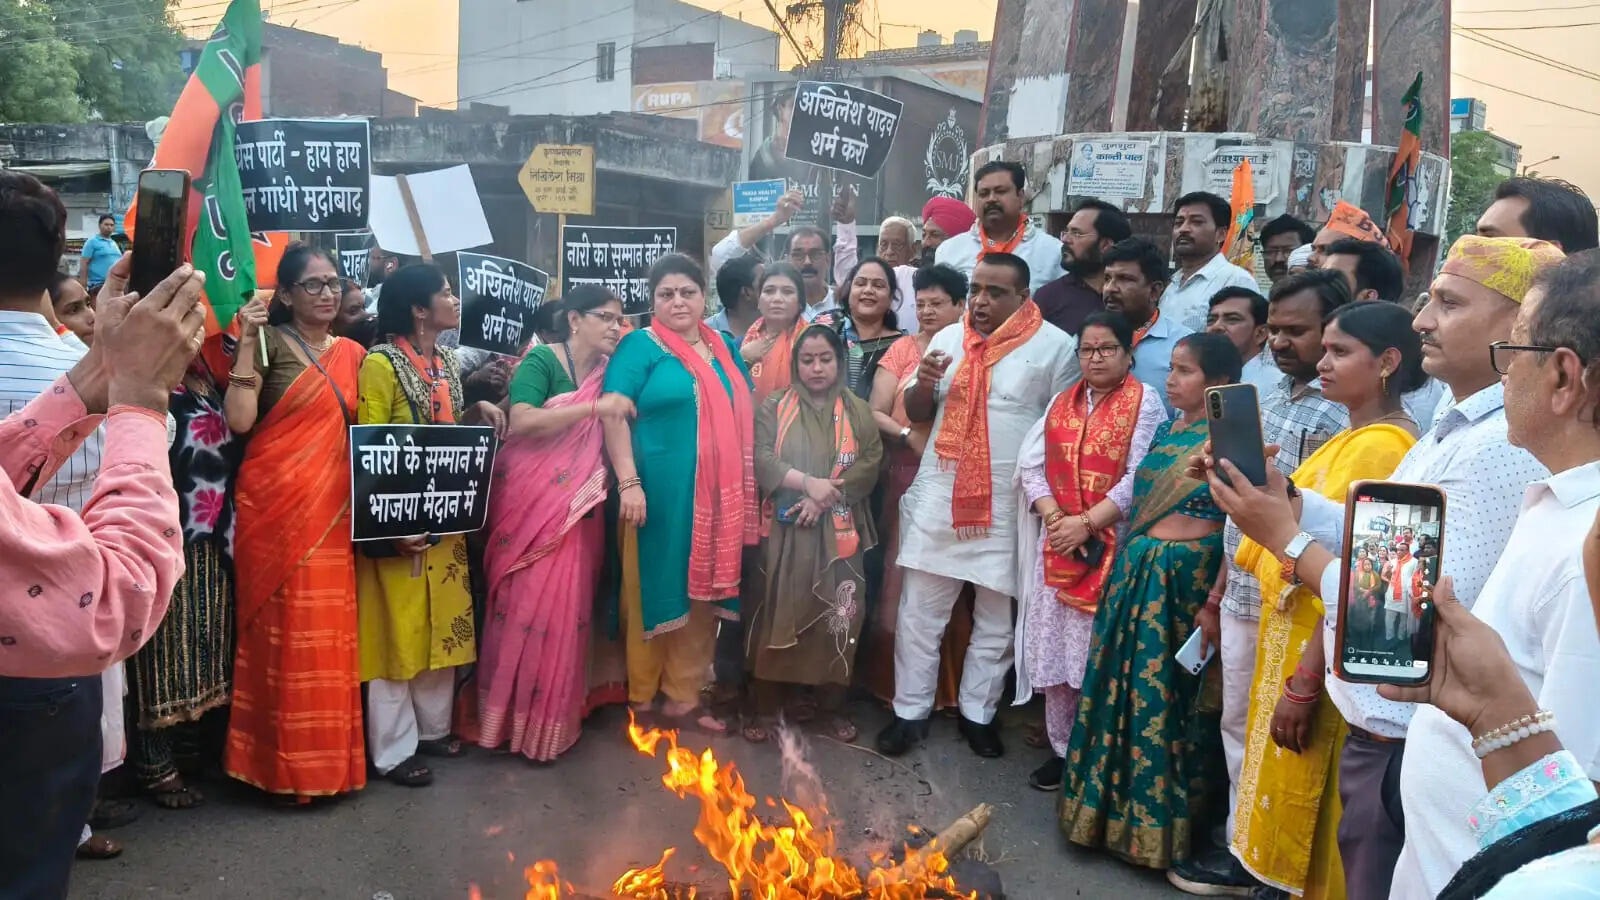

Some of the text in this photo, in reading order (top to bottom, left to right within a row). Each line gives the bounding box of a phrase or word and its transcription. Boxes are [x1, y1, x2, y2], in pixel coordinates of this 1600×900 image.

[647, 92, 692, 107] RUPA
[799, 86, 897, 138] अखिलेश यादव
[235, 134, 255, 170] ग्रेस
[255, 129, 286, 169] पार्टी
[303, 141, 331, 172] हाय
[333, 141, 361, 172] हाय
[810, 126, 868, 165] शर्म करो
[258, 175, 299, 213] गांधी
[301, 175, 363, 222] मुर्दाबाद
[566, 232, 591, 267] नारी
[592, 243, 609, 267] का
[611, 243, 644, 267] सम्मान
[465, 260, 545, 314] अखिलेश यादव
[482, 307, 524, 348] शर्म करो
[359, 433, 489, 475] नारी के सम्मान में
[369, 477, 478, 524] भाजपा मैदान में
